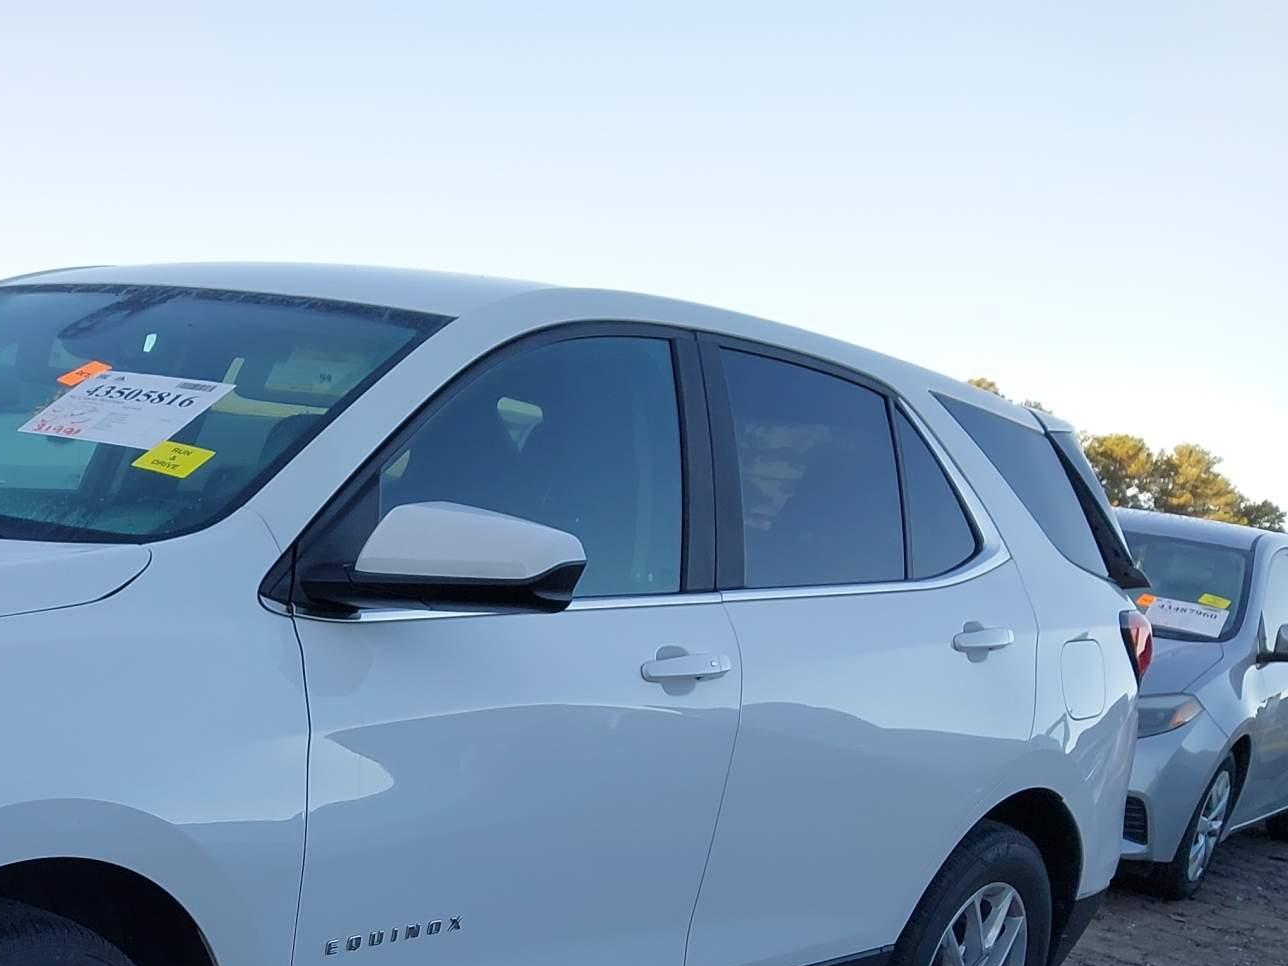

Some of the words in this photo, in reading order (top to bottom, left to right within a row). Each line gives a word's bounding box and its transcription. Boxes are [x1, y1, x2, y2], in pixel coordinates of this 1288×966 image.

[86, 384, 200, 409] 43505816
[171, 447, 193, 457] RUN
[150, 459, 180, 470] DRIVE
[325, 913, 464, 956] EQUINOX
